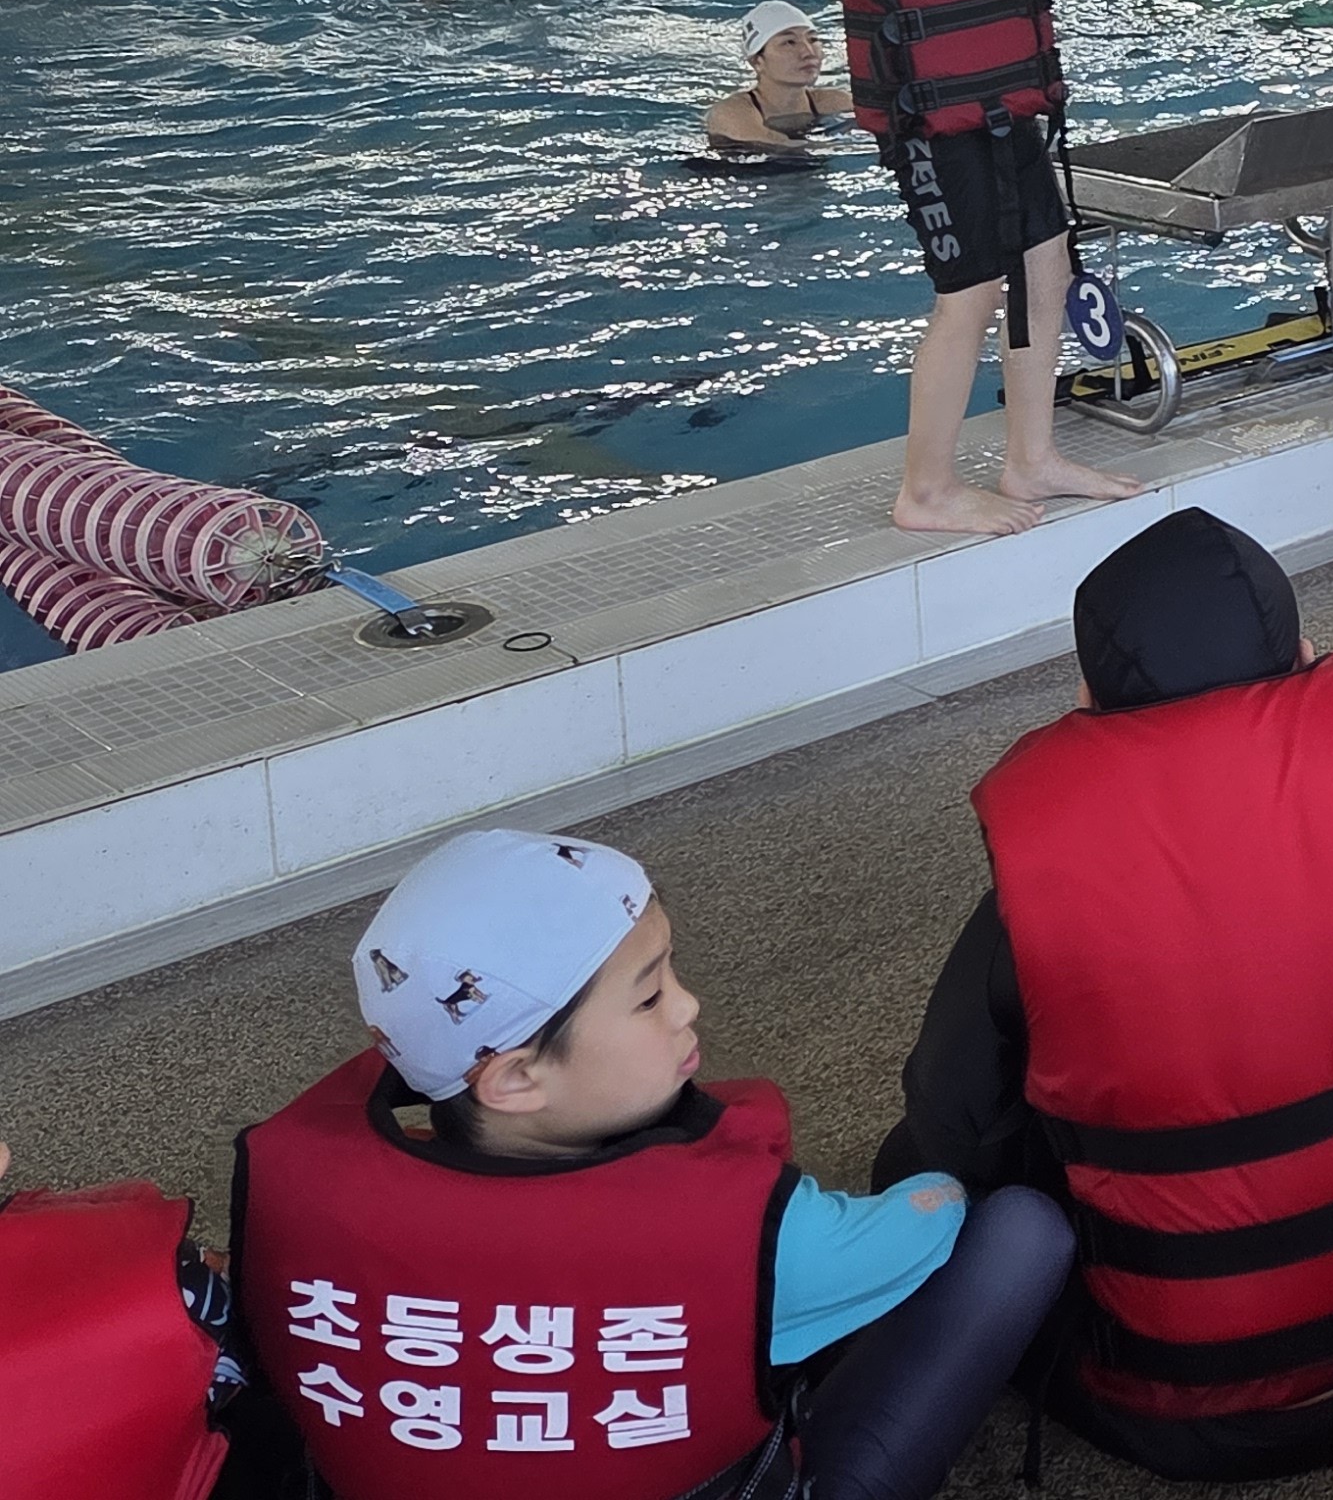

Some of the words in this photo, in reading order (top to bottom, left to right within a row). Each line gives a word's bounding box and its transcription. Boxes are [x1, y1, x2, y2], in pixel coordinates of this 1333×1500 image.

[1078, 282, 1112, 348] 3
[287, 1278, 690, 1373] 초등생존
[298, 1362, 692, 1453] 수영교실
